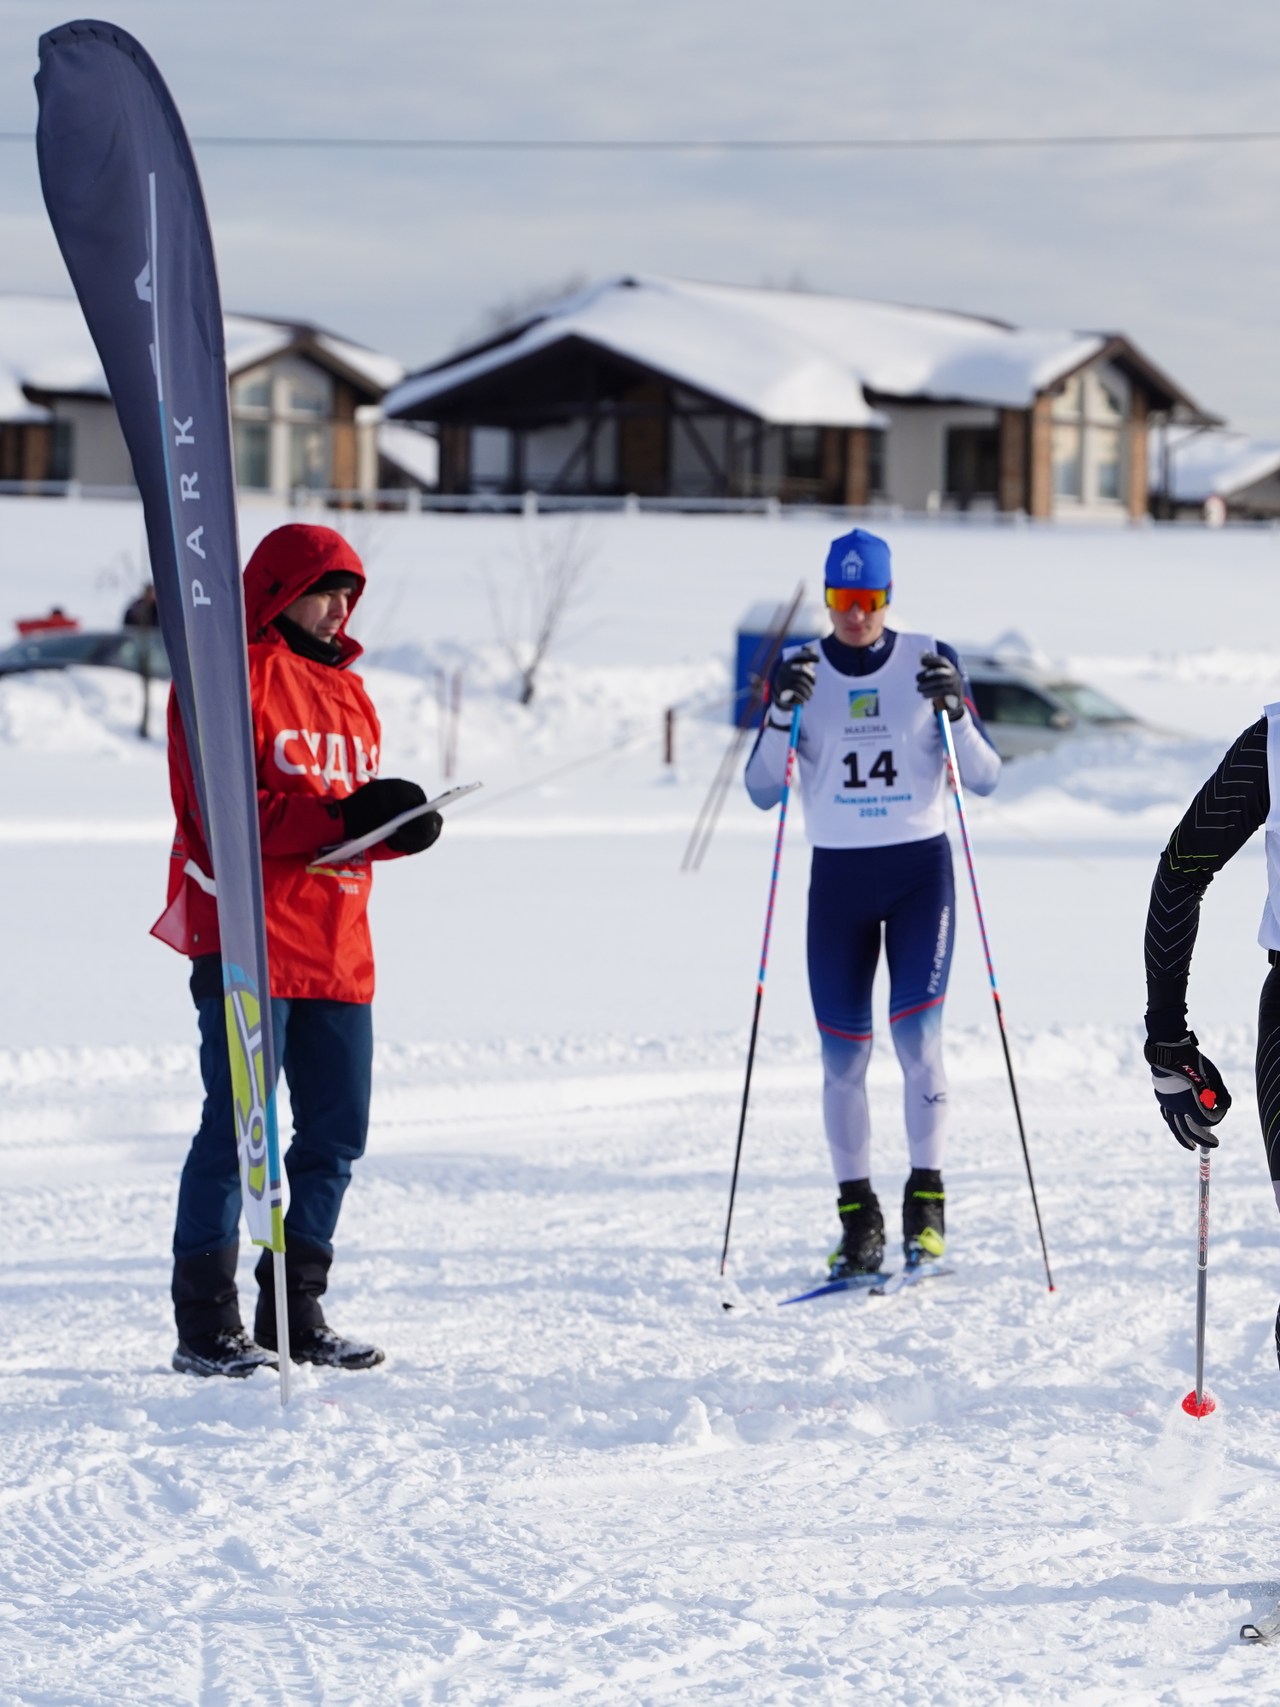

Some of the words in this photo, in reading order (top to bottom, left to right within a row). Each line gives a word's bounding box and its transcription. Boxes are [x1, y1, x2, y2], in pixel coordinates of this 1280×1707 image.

[172, 415, 211, 607] PARK
[842, 750, 898, 788] 14
[859, 806, 888, 818] 2026
